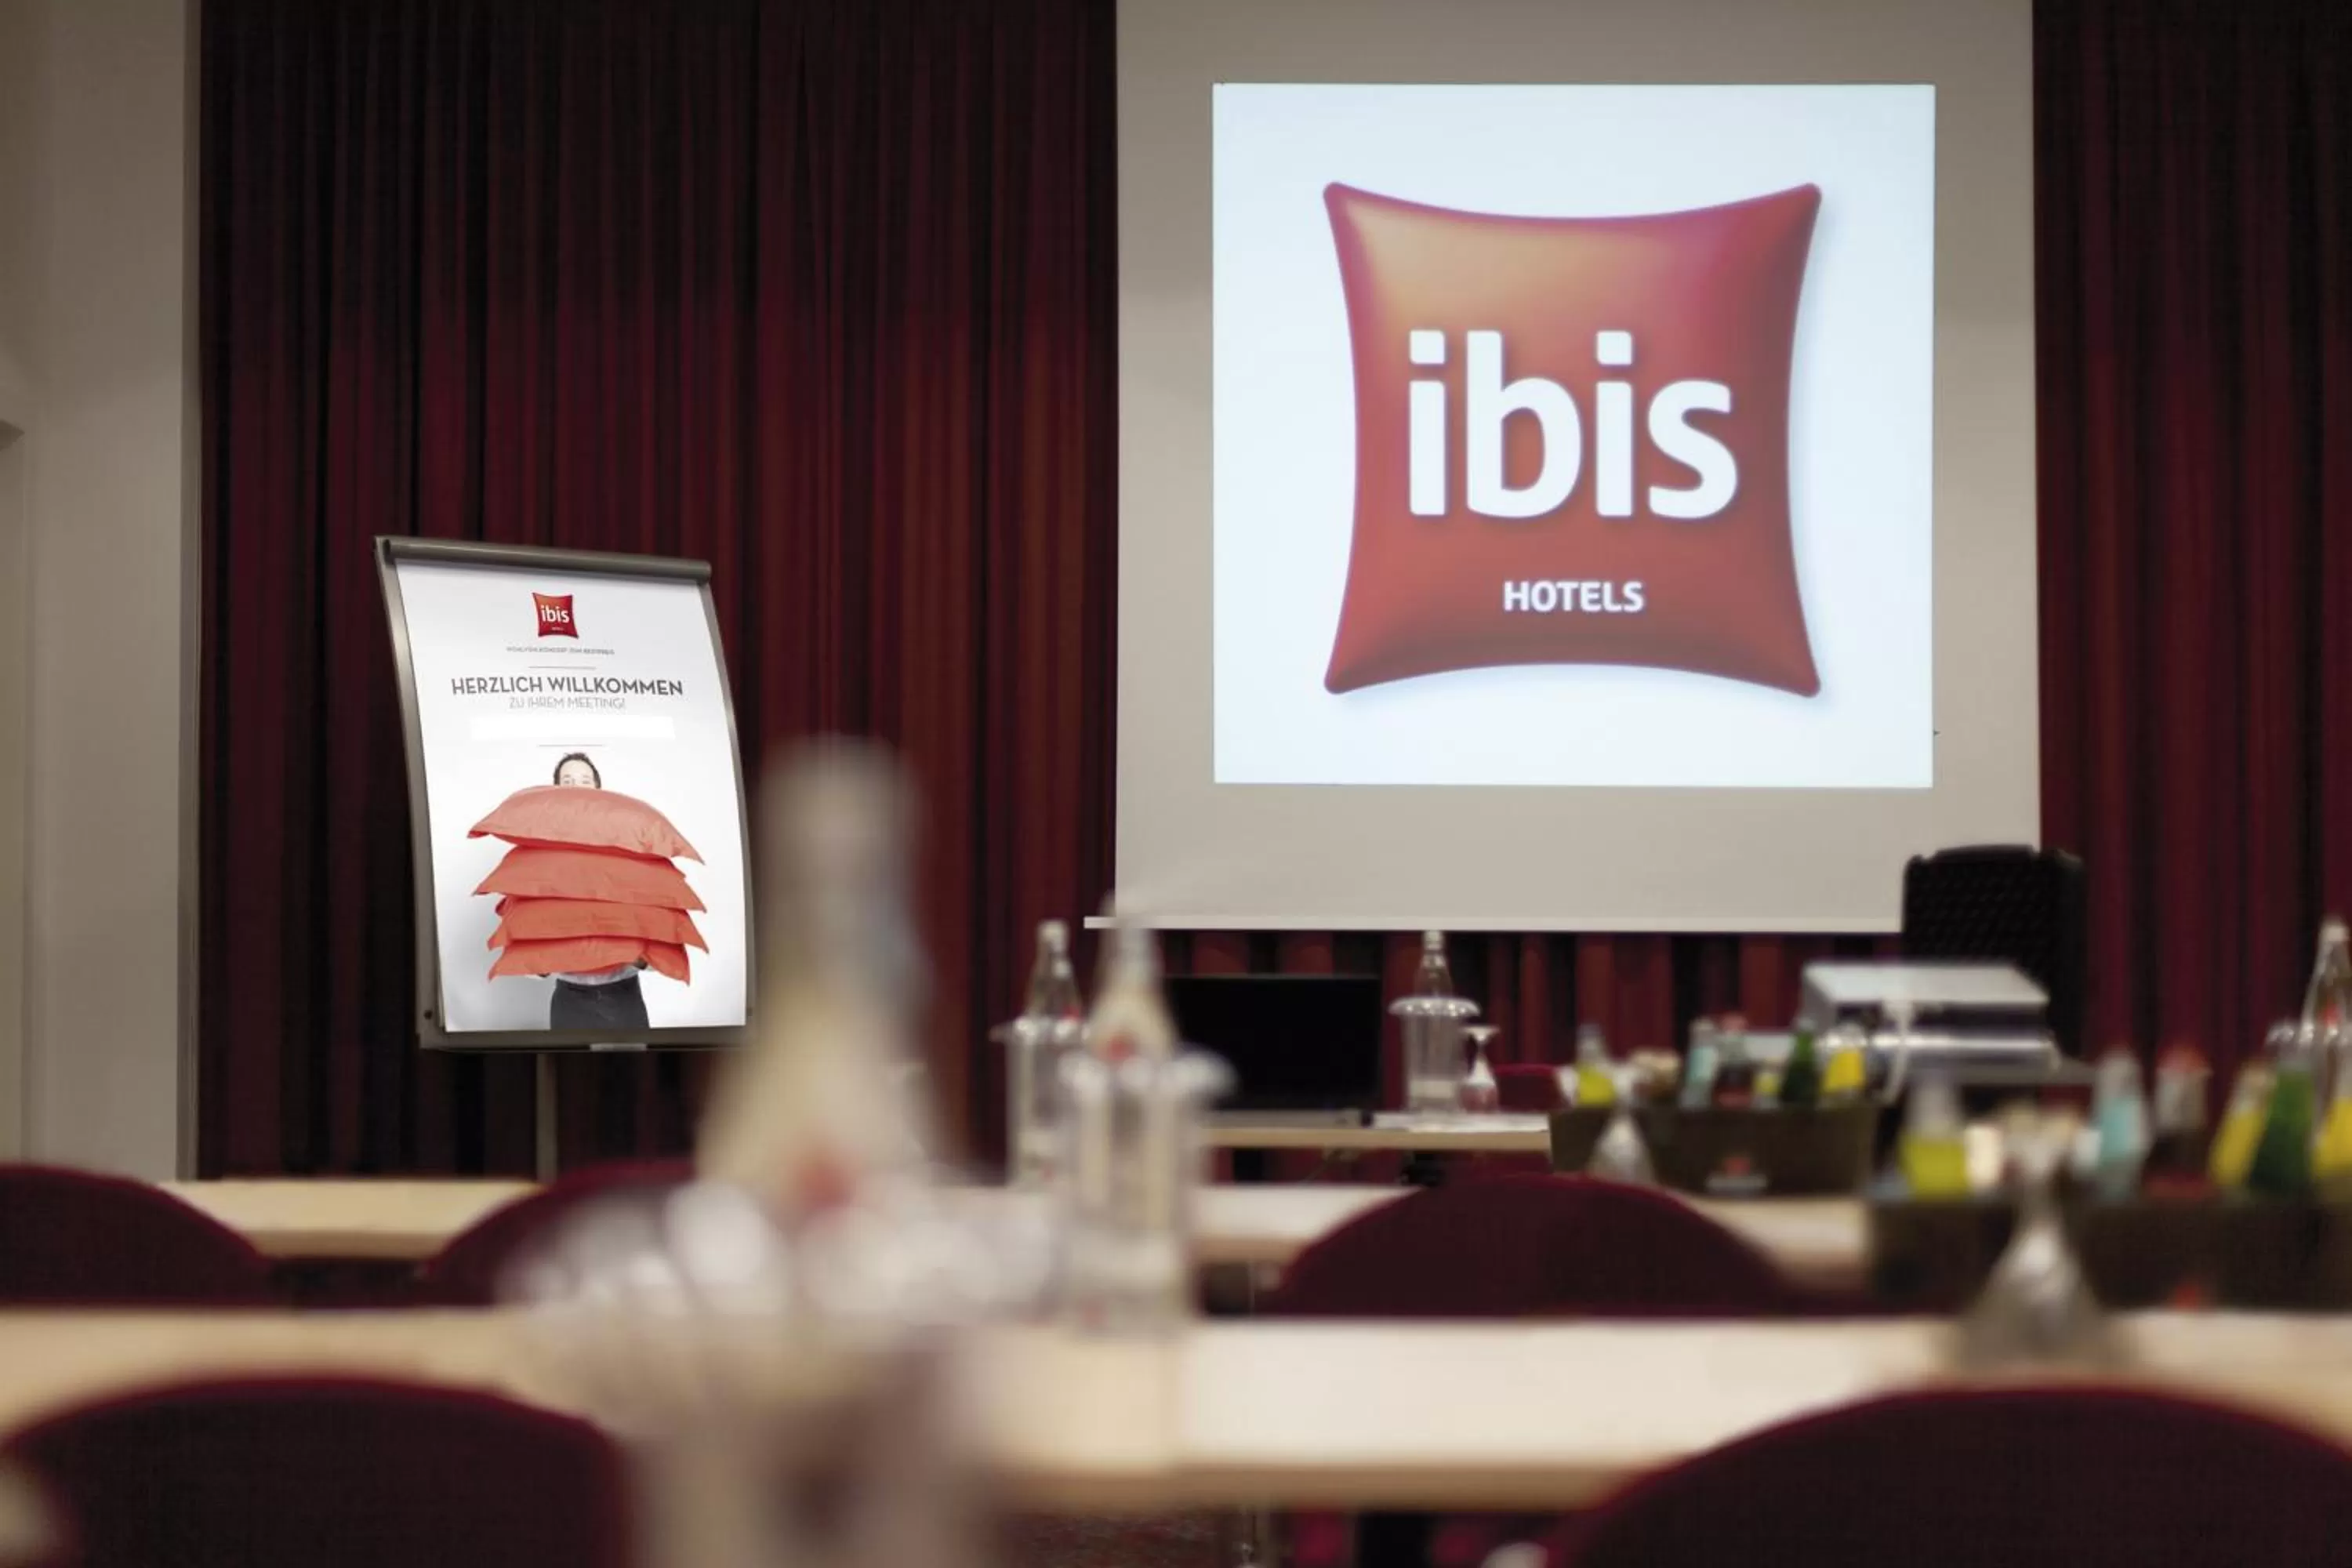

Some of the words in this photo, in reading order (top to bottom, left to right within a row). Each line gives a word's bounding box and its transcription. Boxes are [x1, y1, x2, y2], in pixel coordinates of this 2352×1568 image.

[1409, 329, 1737, 519] ibis
[1503, 581, 1645, 612] HOTELS
[540, 604, 570, 623] ibis
[452, 676, 543, 695] HERZLICH
[547, 676, 684, 695] WILLKOMMEN
[510, 696, 524, 709] ZU
[528, 696, 565, 709] IHREM
